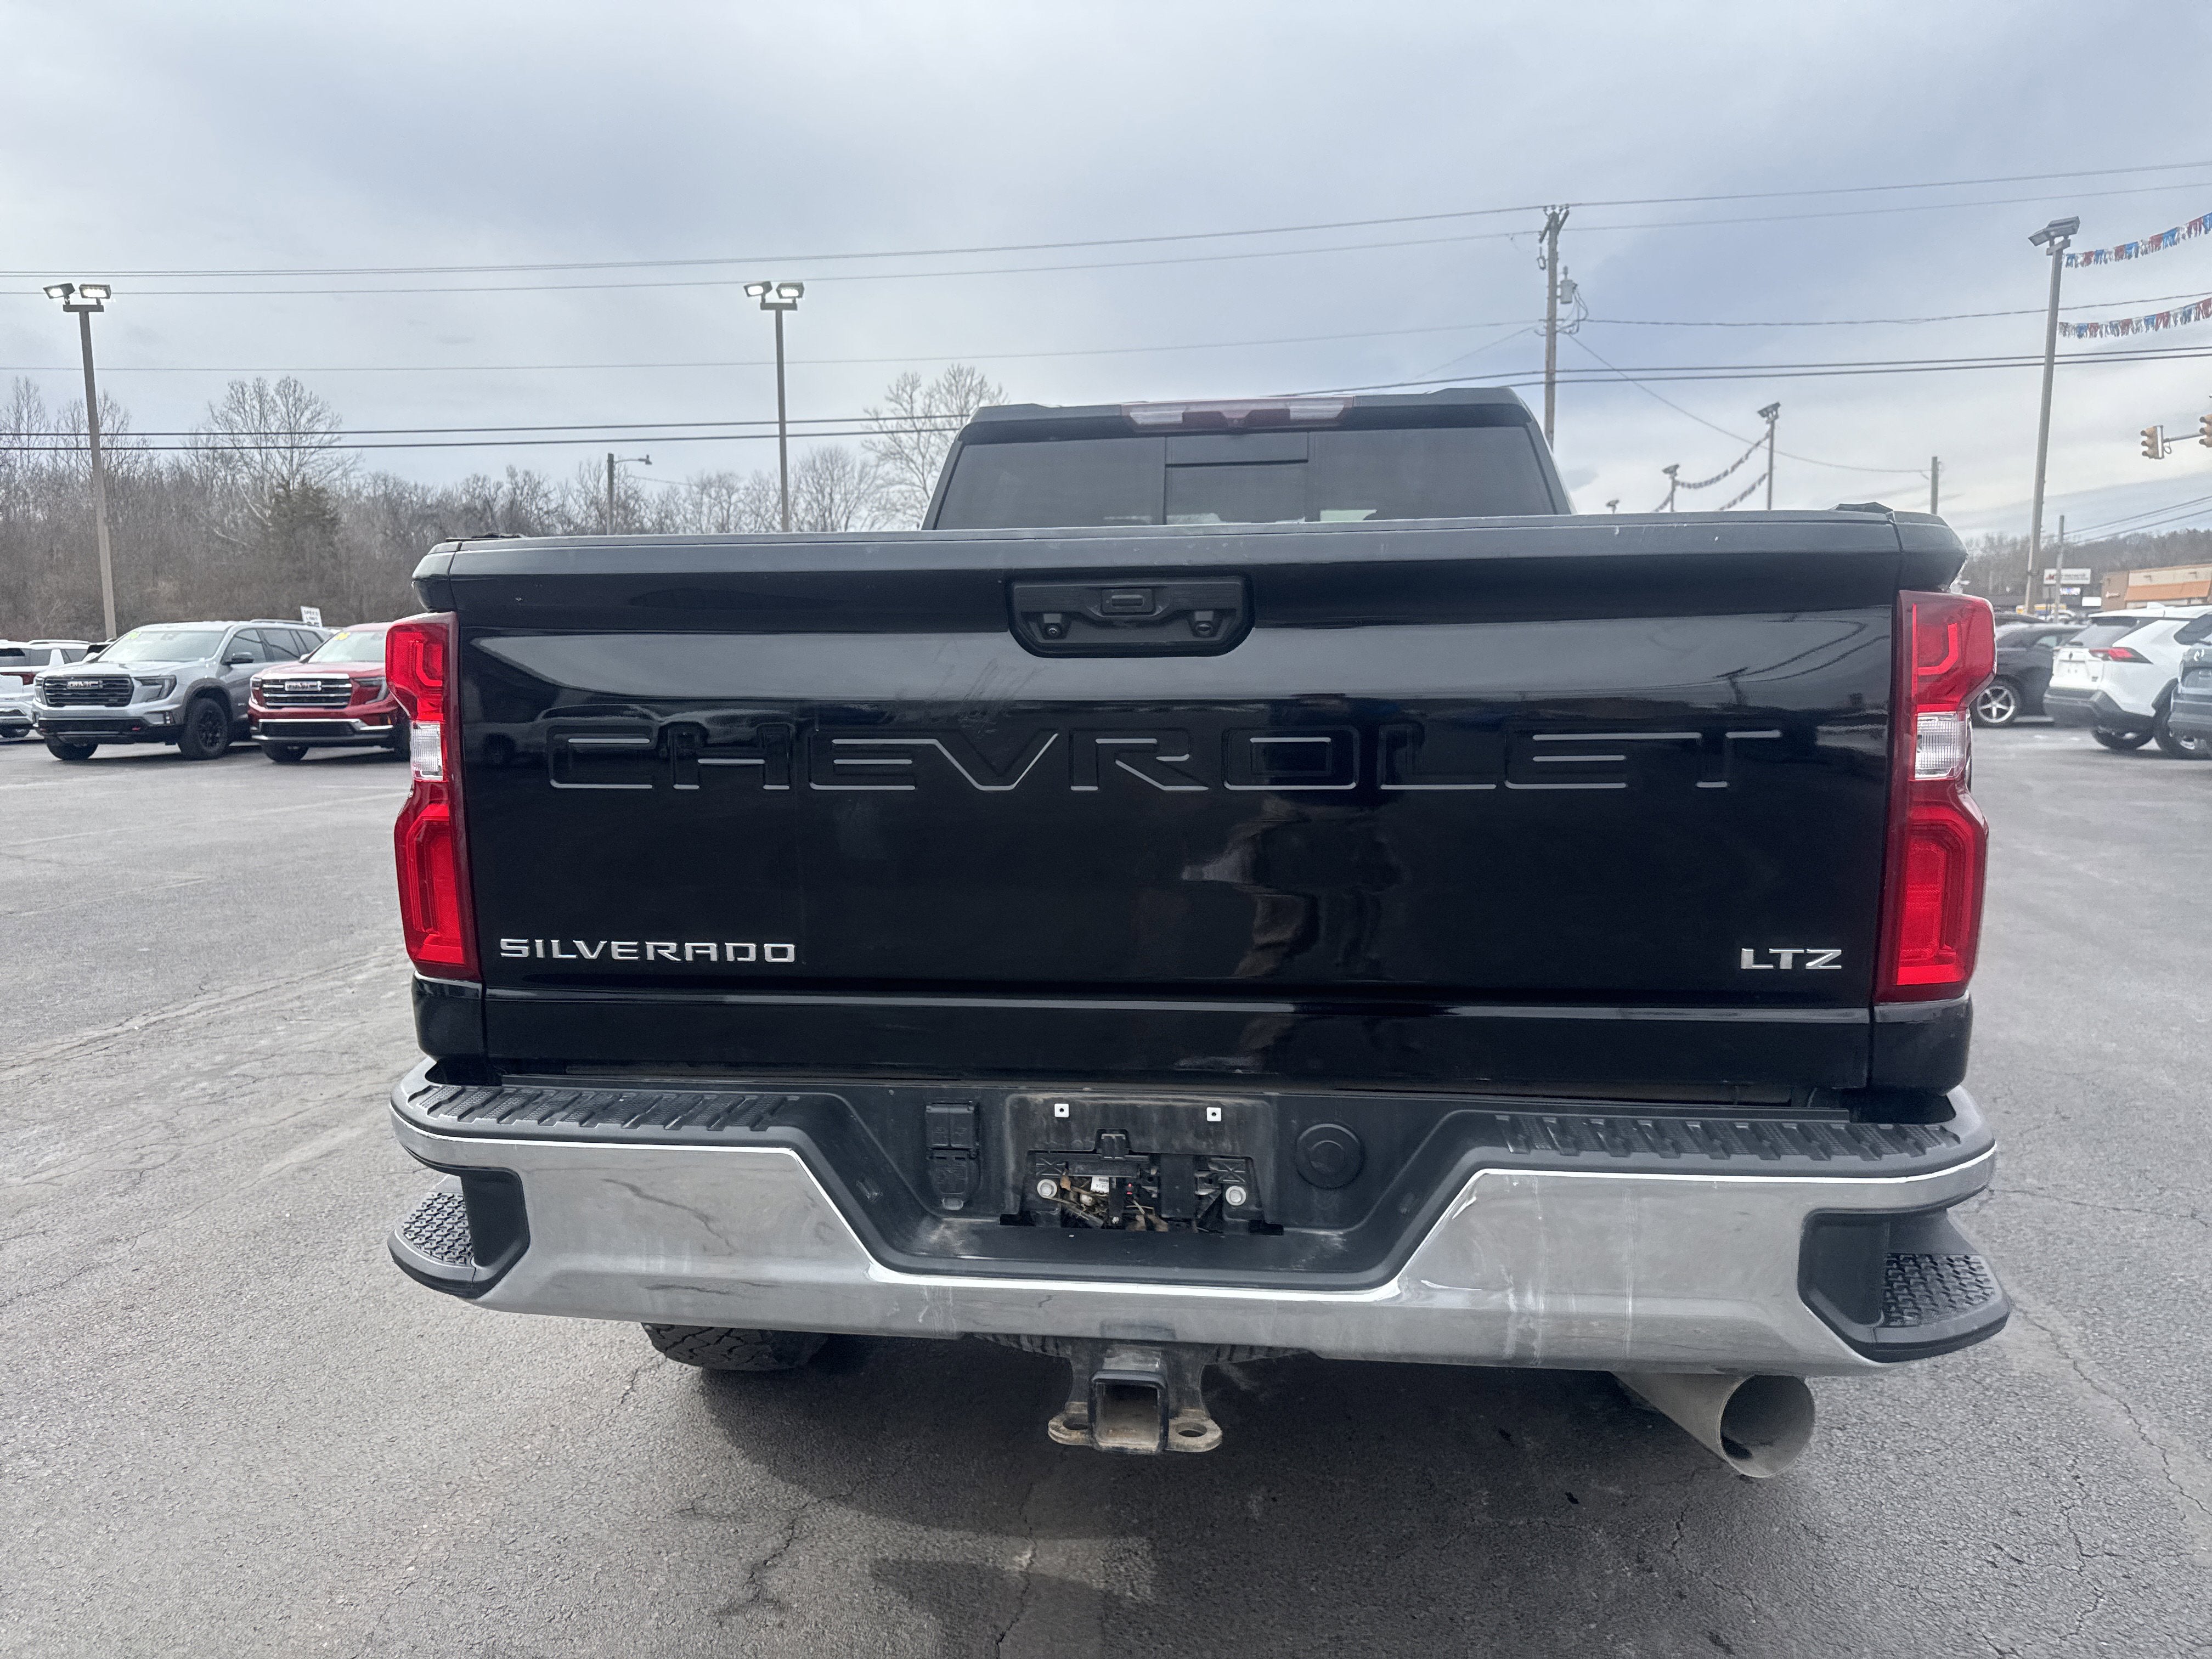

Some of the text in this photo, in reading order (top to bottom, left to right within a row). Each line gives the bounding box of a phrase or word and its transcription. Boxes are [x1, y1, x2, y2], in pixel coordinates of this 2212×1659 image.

[67, 681, 103, 690] GMC
[285, 681, 321, 691] GMC
[549, 723, 1783, 791] CHEVROLET
[500, 938, 796, 963] SILVERADO
[1741, 948, 1842, 969] LTZ
